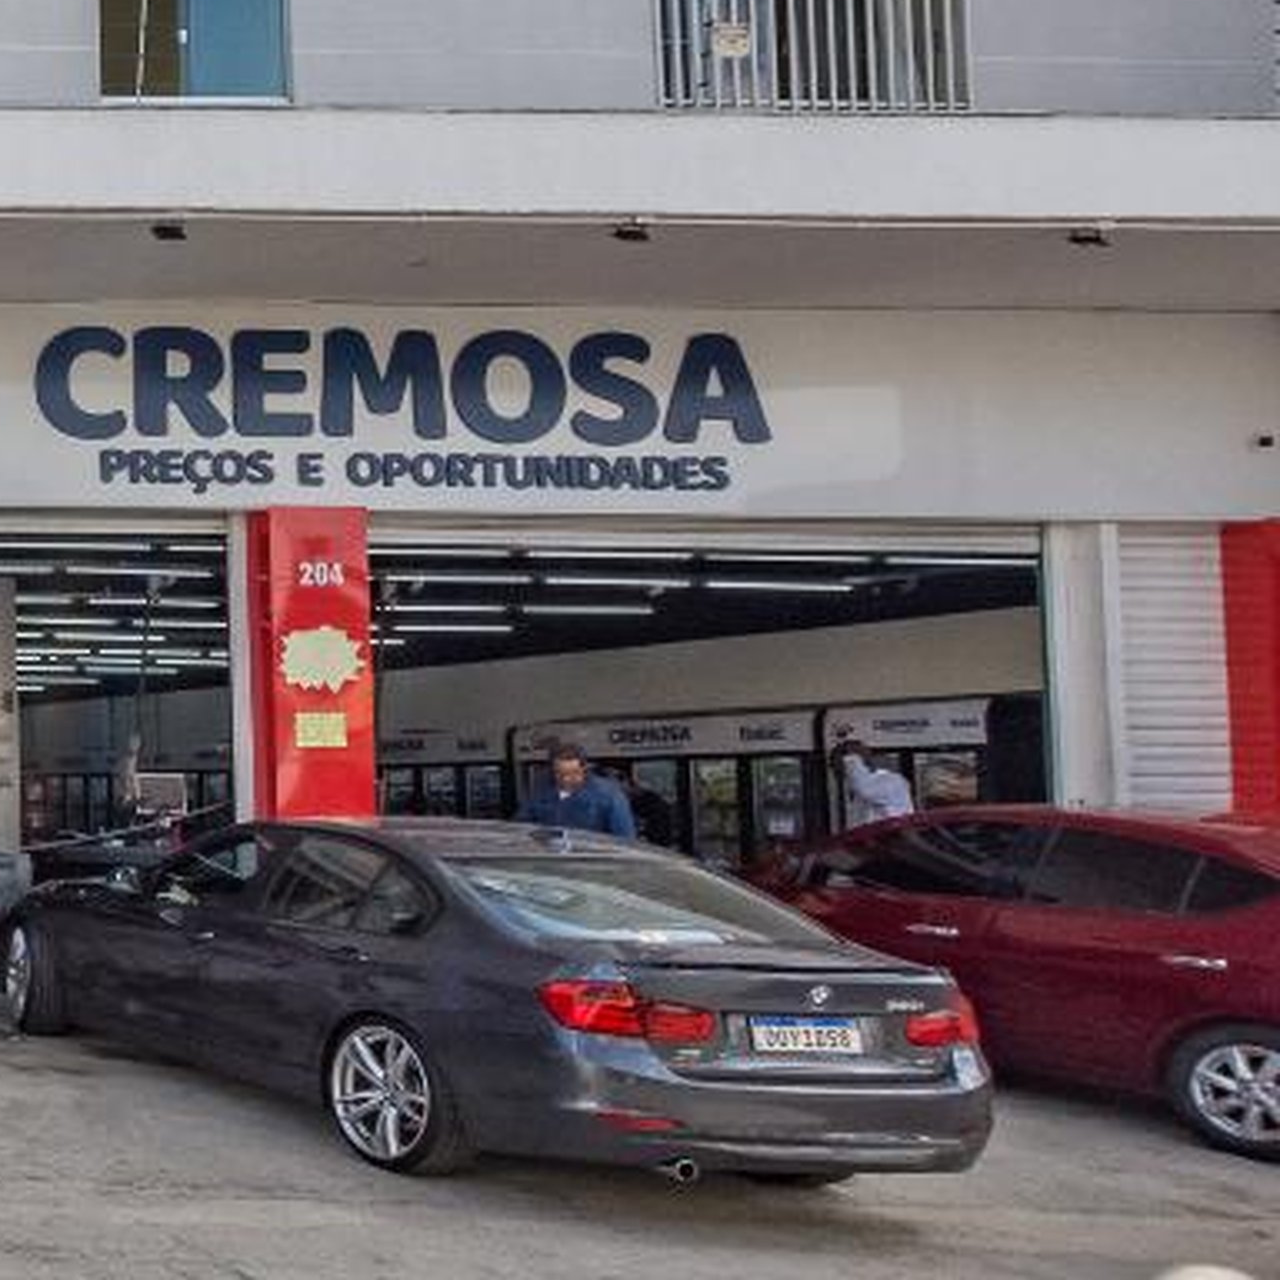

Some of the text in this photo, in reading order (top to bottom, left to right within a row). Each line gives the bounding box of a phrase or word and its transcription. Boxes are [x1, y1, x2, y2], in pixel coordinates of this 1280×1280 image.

[33, 325, 773, 446] CREMOSA
[99, 448, 731, 494] PREÇOS E OPORTUNIDADES
[298, 561, 345, 587] 204
